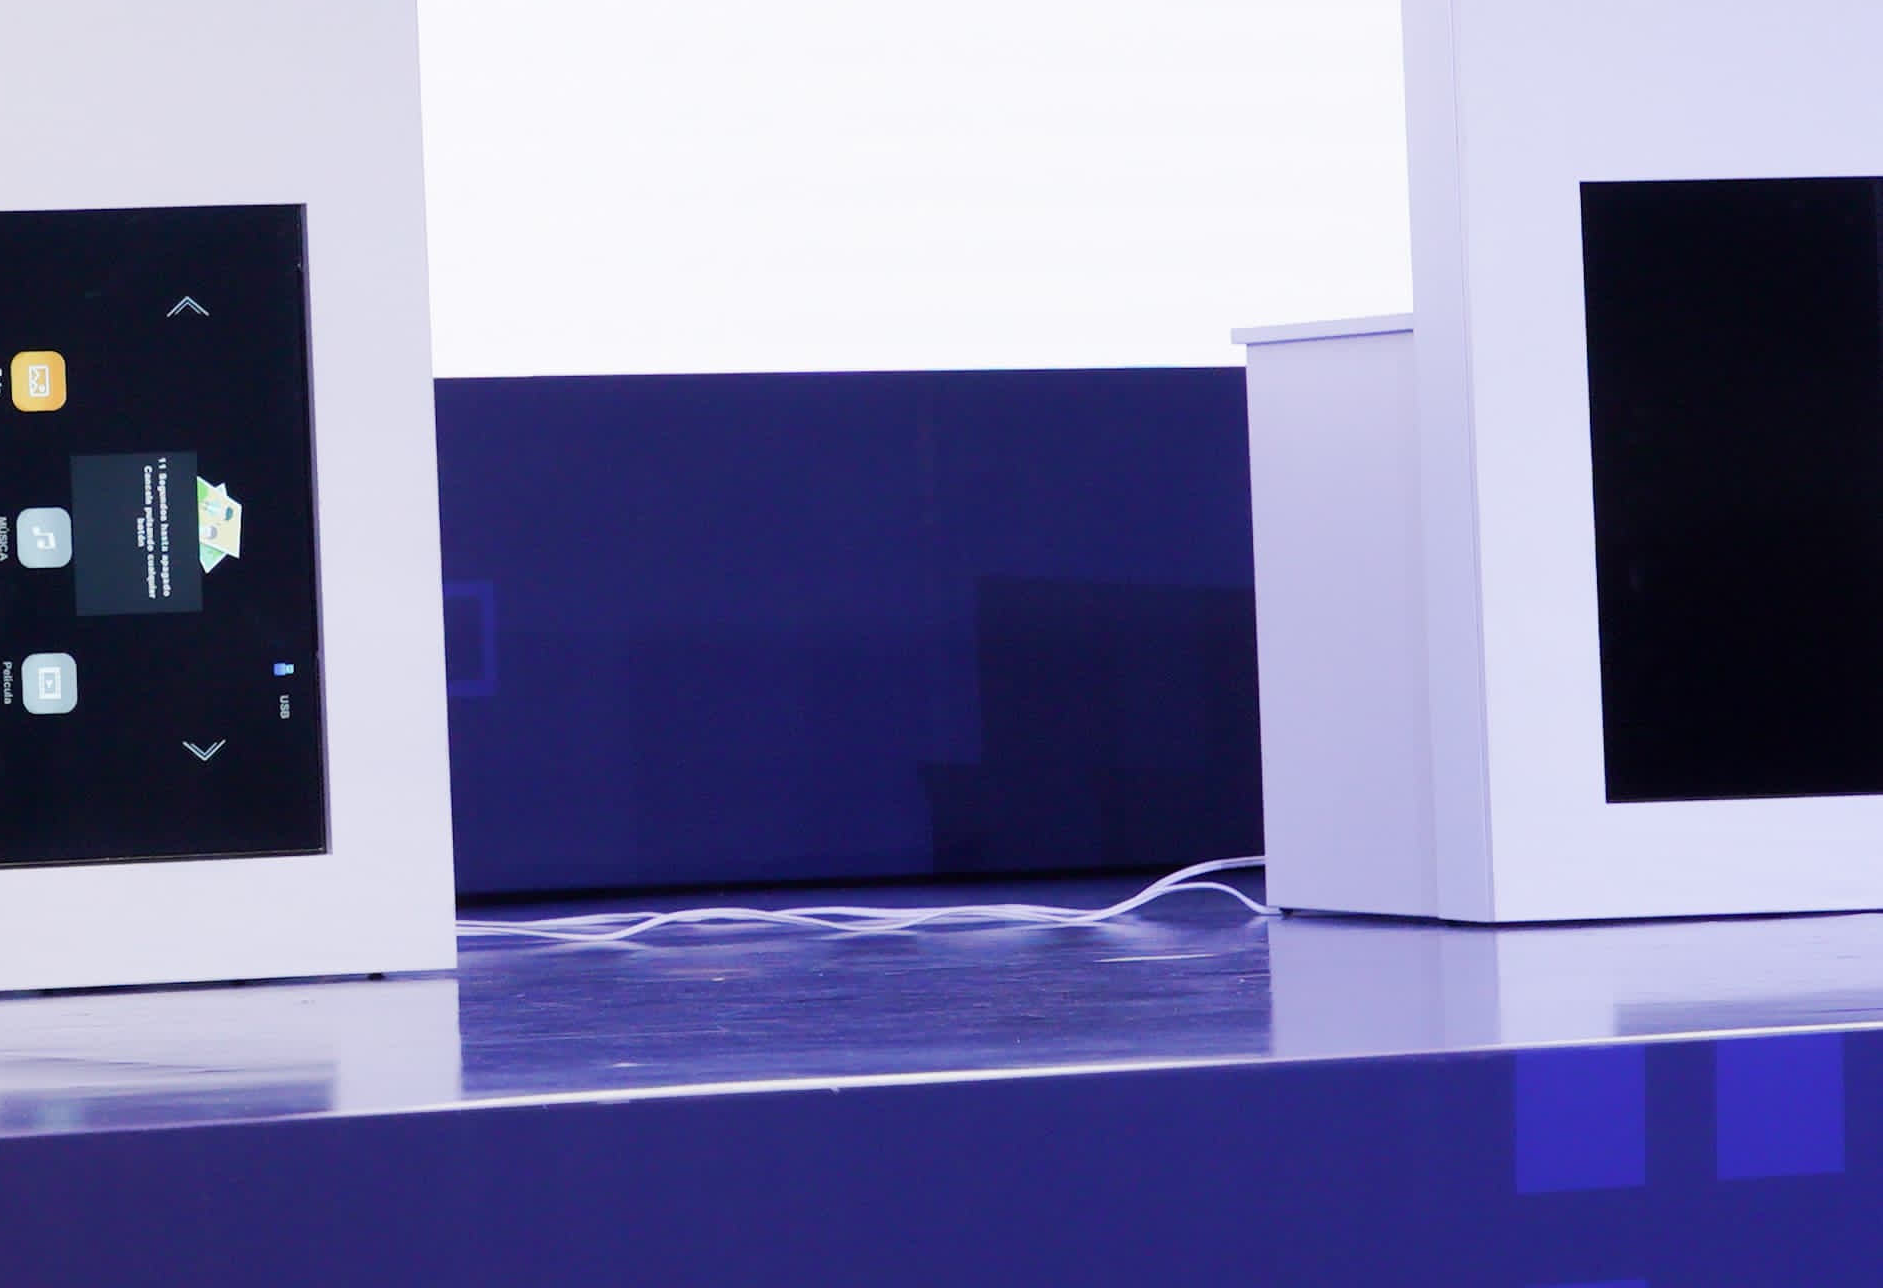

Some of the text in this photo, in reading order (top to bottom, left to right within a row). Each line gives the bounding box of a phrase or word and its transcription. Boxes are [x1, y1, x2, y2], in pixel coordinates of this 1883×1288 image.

[144, 507, 155, 552] pulsando
[157, 457, 171, 597] 11 Segundos hasta apagado
[147, 554, 157, 599] cualquier
[279, 694, 291, 720] USB
